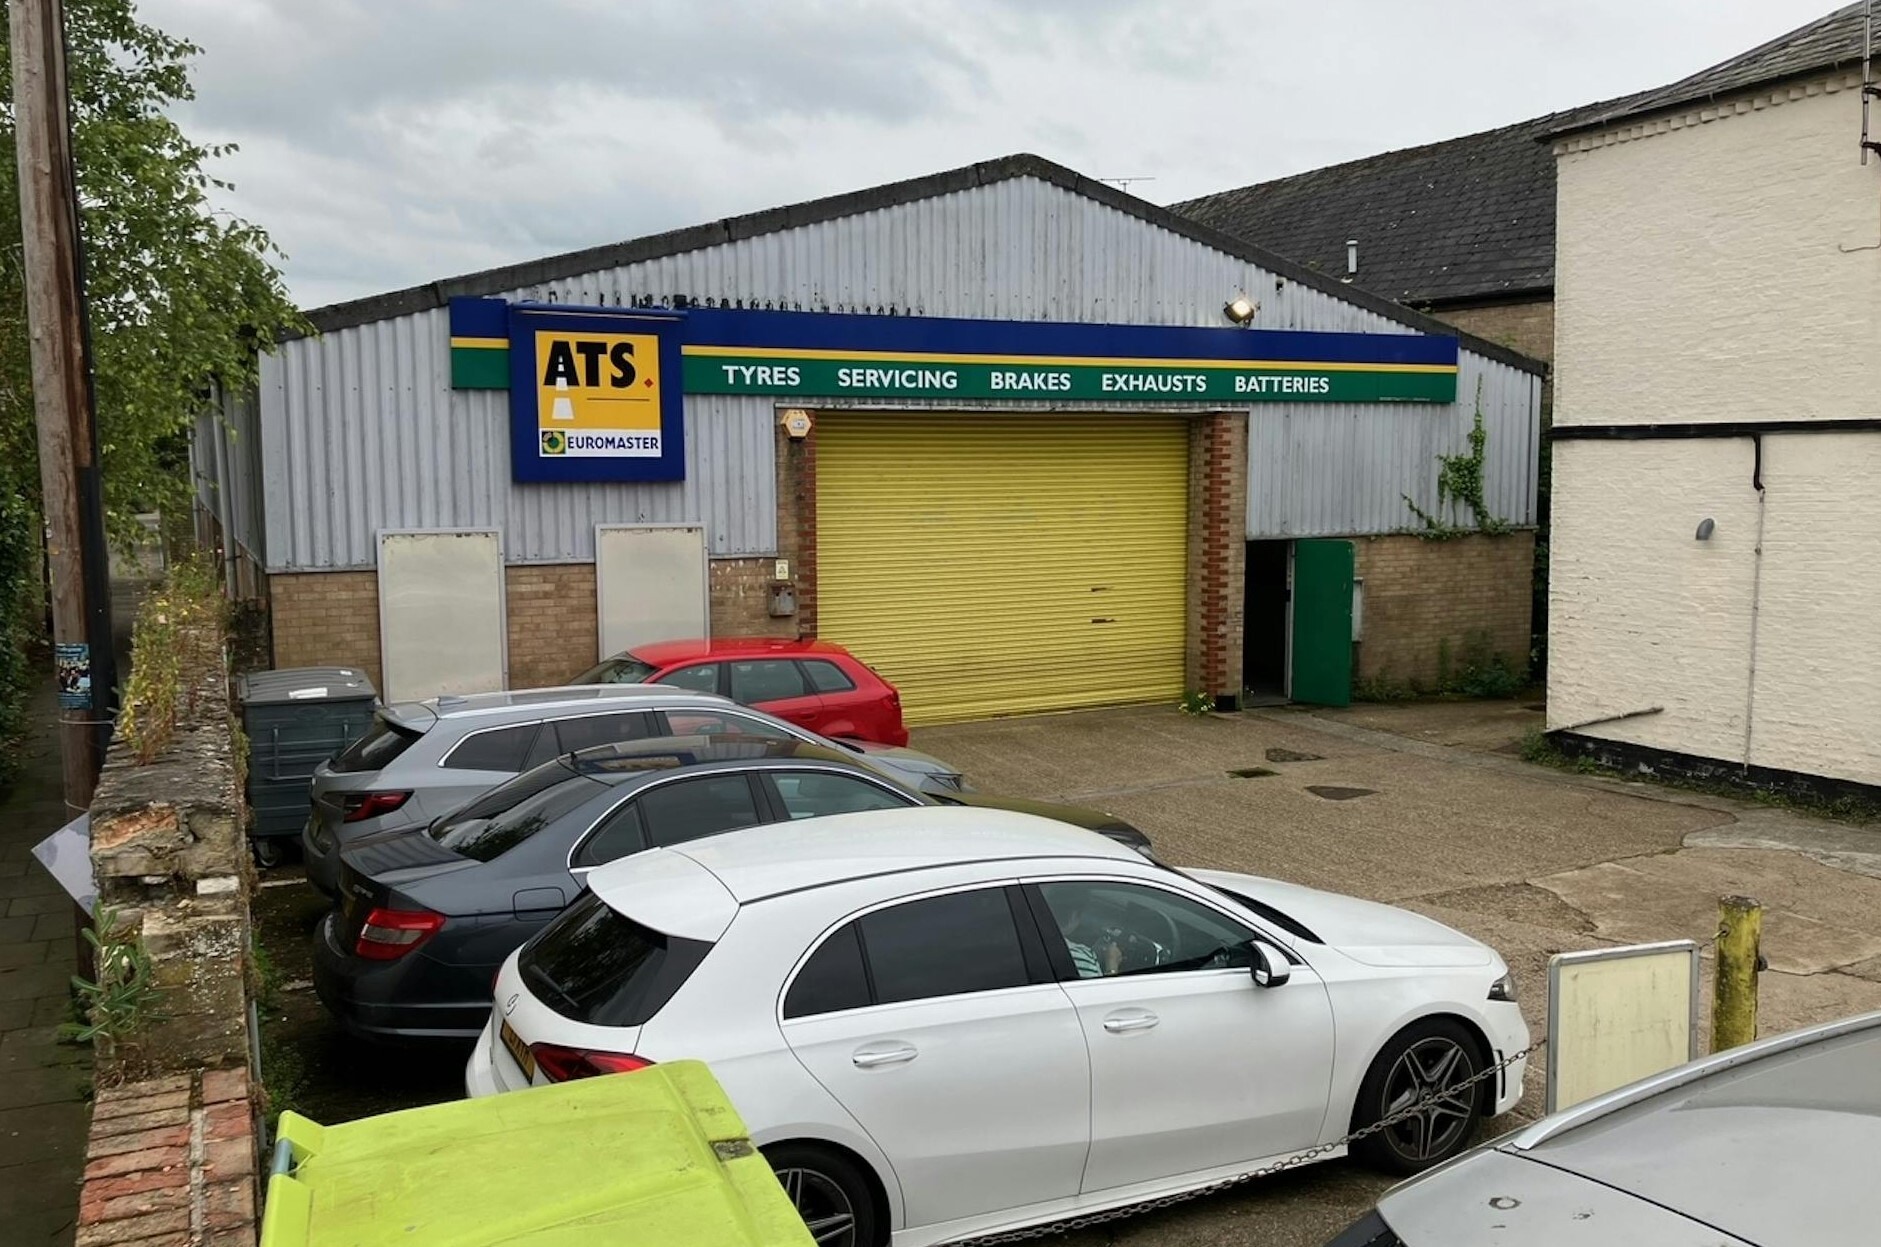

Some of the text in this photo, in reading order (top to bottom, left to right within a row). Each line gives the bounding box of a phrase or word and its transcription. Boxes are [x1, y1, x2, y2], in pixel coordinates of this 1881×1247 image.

[543, 340, 636, 389] ATS
[722, 365, 1330, 394] TYRES SERVICING BRAKES EXHAUSTS BATTERIES
[567, 436, 660, 450] EUROMASTER
